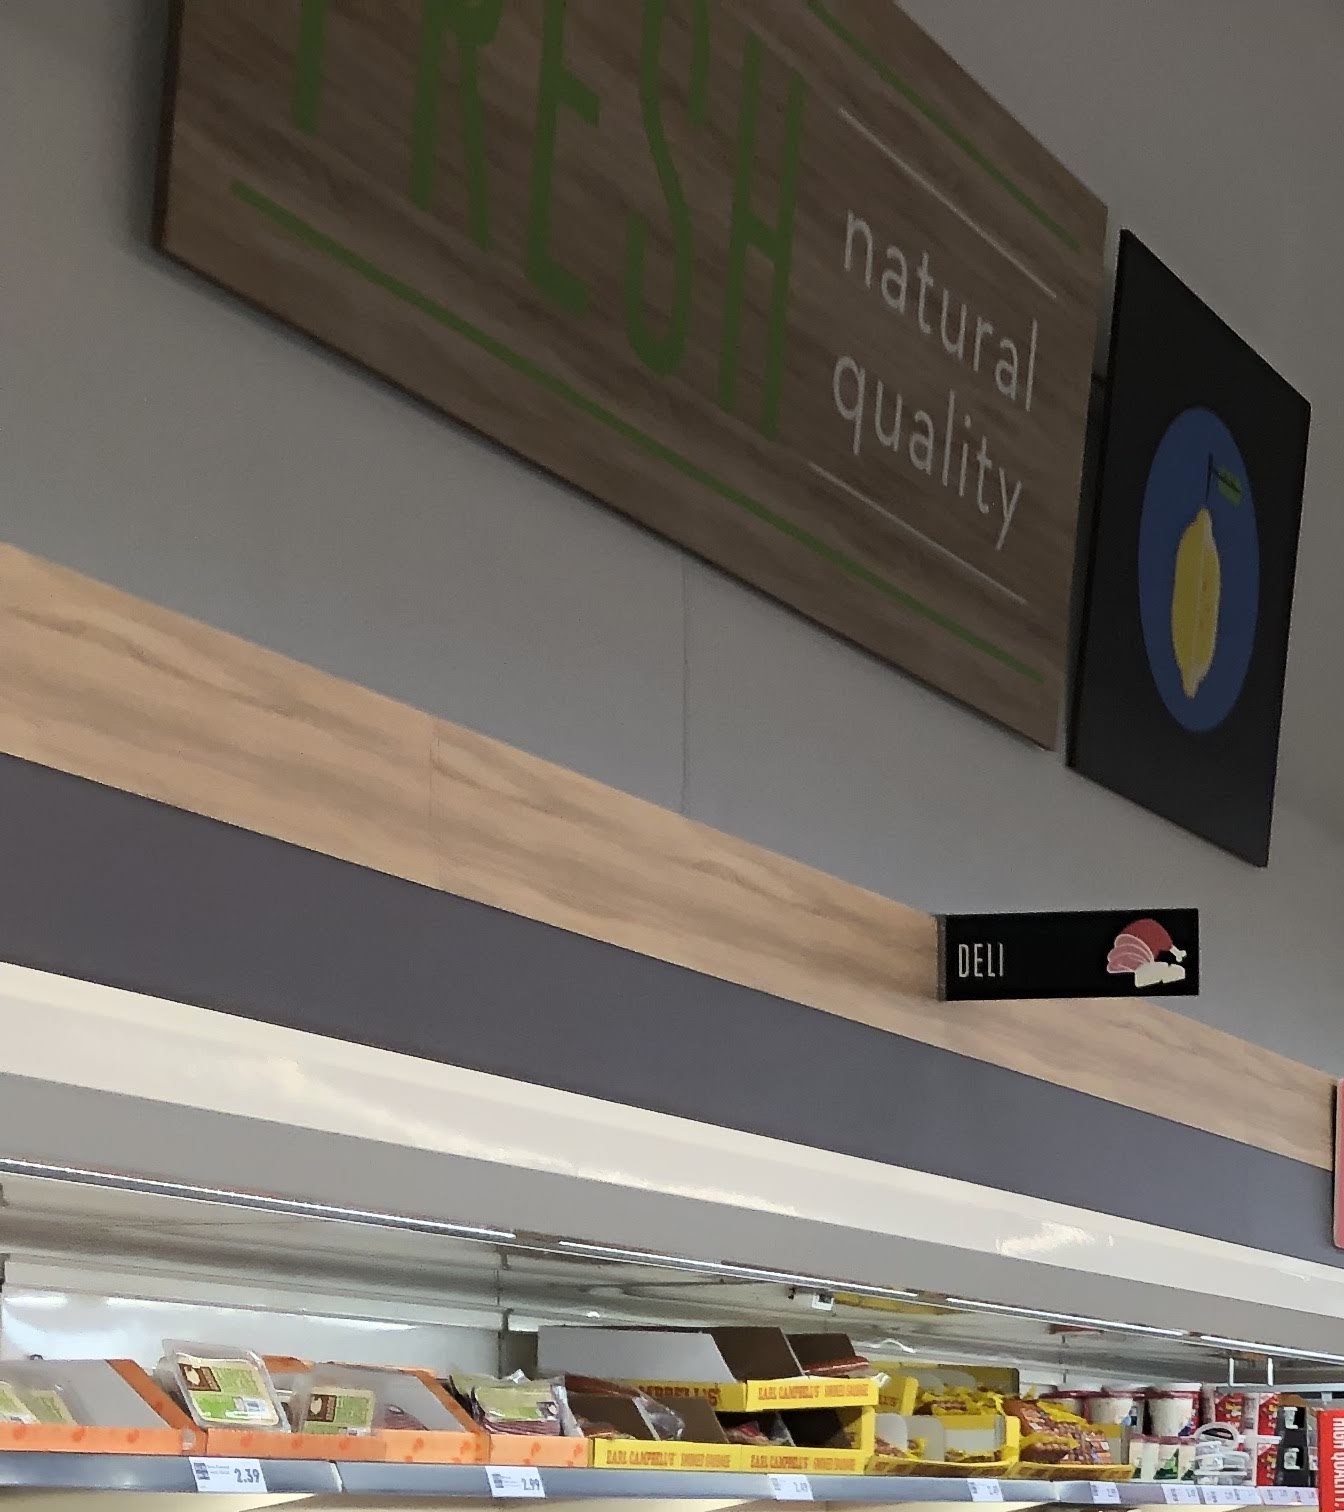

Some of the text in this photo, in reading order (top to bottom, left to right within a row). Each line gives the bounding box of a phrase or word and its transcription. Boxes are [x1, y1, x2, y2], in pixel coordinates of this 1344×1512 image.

[845, 206, 1038, 411] natural
[831, 354, 1023, 549] quality
[957, 942, 1004, 978] DELI
[234, 1468, 261, 1485] 2.39
